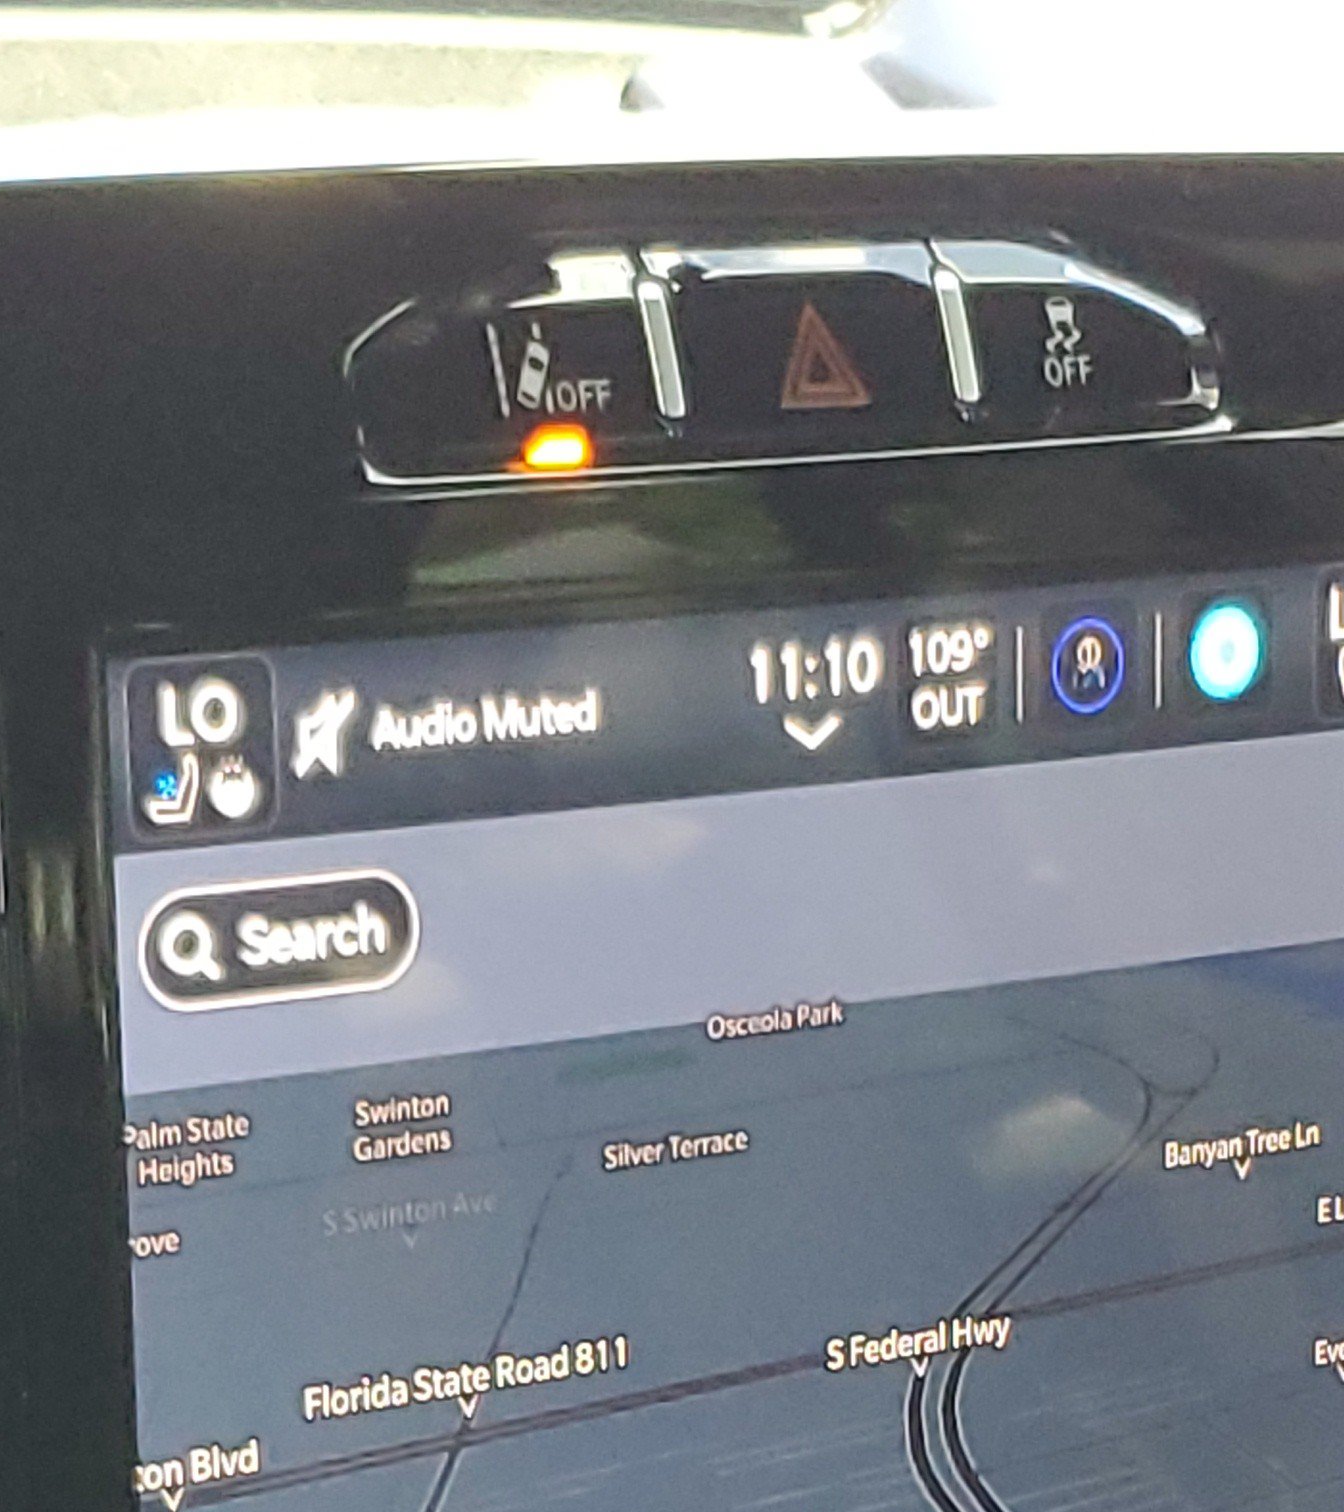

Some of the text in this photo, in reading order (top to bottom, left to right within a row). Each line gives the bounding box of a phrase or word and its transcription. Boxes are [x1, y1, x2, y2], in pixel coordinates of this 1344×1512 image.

[1043, 355, 1091, 388] OFF
[556, 379, 612, 414] OFF
[749, 633, 881, 704] 11:10
[158, 679, 241, 747] LO
[370, 690, 601, 752] Audio Muted
[910, 686, 987, 732] OUT
[236, 905, 389, 969] Search
[796, 1000, 845, 1030] Park
[185, 1113, 250, 1145] State
[355, 1094, 450, 1127] Swinton
[353, 1128, 453, 1163] Gardens
[602, 1130, 750, 1171] Silver Terrace
[1164, 1121, 1320, 1170] Banyan Tree Ln
[137, 1152, 236, 1187] Heights
[323, 1213, 338, 1237] S
[344, 1198, 446, 1233] Swinton
[1318, 1196, 1333, 1224] E
[826, 1316, 1011, 1370] S Federal Hwy
[303, 1336, 628, 1422] Florida State Road 811
[190, 1437, 259, 1482] Blvd
